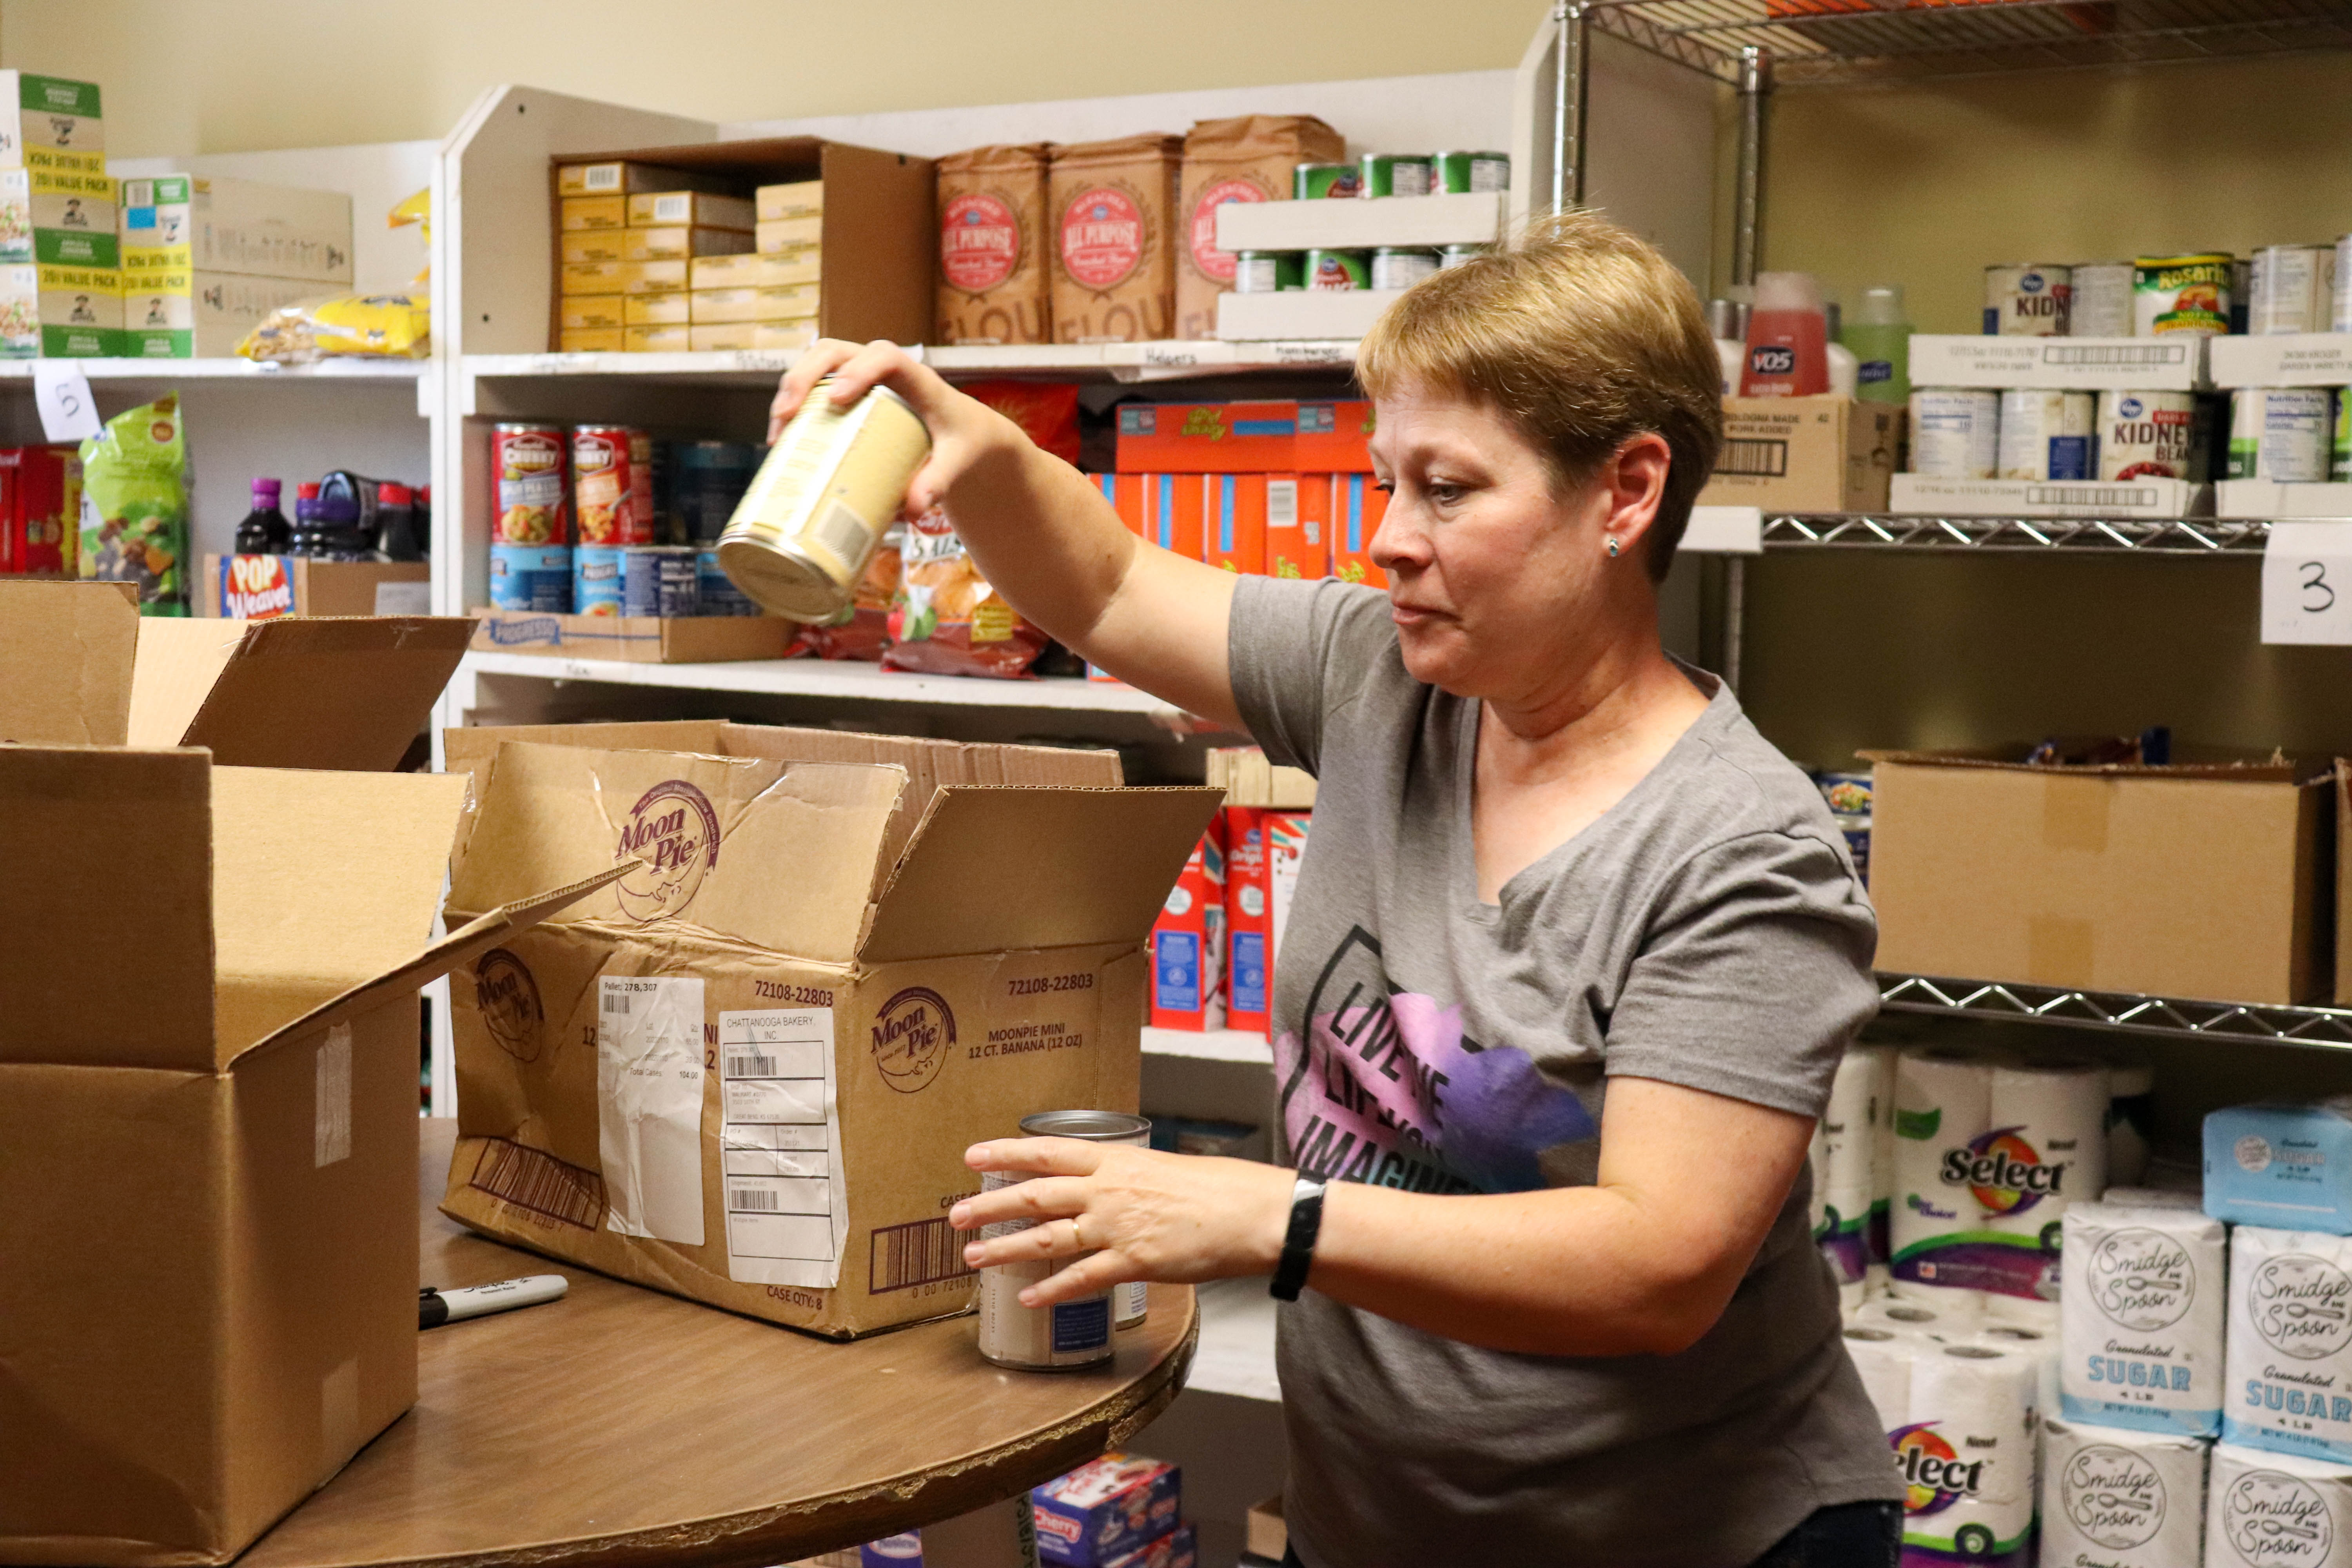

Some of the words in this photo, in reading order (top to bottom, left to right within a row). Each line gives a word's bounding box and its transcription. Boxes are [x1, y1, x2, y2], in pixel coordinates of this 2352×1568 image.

[1759, 425, 1792, 434] ADDED
[1773, 414, 1800, 423] MADE
[232, 556, 278, 593] POP
[2299, 561, 2335, 613] 3
[227, 585, 292, 619] Weaver
[614, 808, 686, 860] Moon
[650, 836, 695, 877] Pie
[474, 971, 520, 1012] Moon
[605, 982, 622, 991] Pallet:
[624, 983, 657, 992] 278,307
[756, 980, 833, 1007] 72108-22803
[1009, 973, 1093, 996] 72108-22803
[583, 1026, 595, 1046] 12
[727, 1017, 782, 1028] CHATTANOOGA
[783, 1016, 816, 1027] BAKERY,
[871, 1006, 926, 1054] Moon
[988, 1025, 1038, 1043] MOONPIE
[1041, 1022, 1065, 1036] MINI
[906, 1025, 938, 1060] Pie
[969, 1046, 981, 1059] 12
[984, 1044, 998, 1057] CT.
[1002, 1039, 1045, 1055] BANANA
[1047, 1037, 1063, 1052] (12
[1066, 1034, 1082, 1049] OZ)
[630, 1067, 643, 1076] Total
[679, 1071, 699, 1079] 104.00
[1940, 1146, 2067, 1195] Select
[2274, 1151, 2326, 1165] SUGAR
[2099, 1241, 2188, 1278] Smidge
[767, 1285, 791, 1302] CASE
[793, 1292, 814, 1308] QTY:
[816, 1298, 822, 1310] 8
[913, 1287, 918, 1299] 0
[925, 1284, 936, 1296] 00
[943, 1276, 972, 1293] 72108
[2102, 1278, 2176, 1319] Spoon
[2258, 1266, 2352, 1307] Smidge
[2262, 1304, 2339, 1345] Spoon
[2105, 1339, 2174, 1358] Granulated
[2088, 1355, 2192, 1392] SUGAR
[2263, 1364, 2336, 1388] Granulated
[2246, 1380, 2351, 1423] SUGAR
[1965, 1436, 1997, 1449] New!
[2071, 1455, 2159, 1497] Smidge
[2073, 1494, 2147, 1535] Spoon
[2233, 1481, 2325, 1524] Smidge
[2236, 1519, 2312, 1561] Spoon
